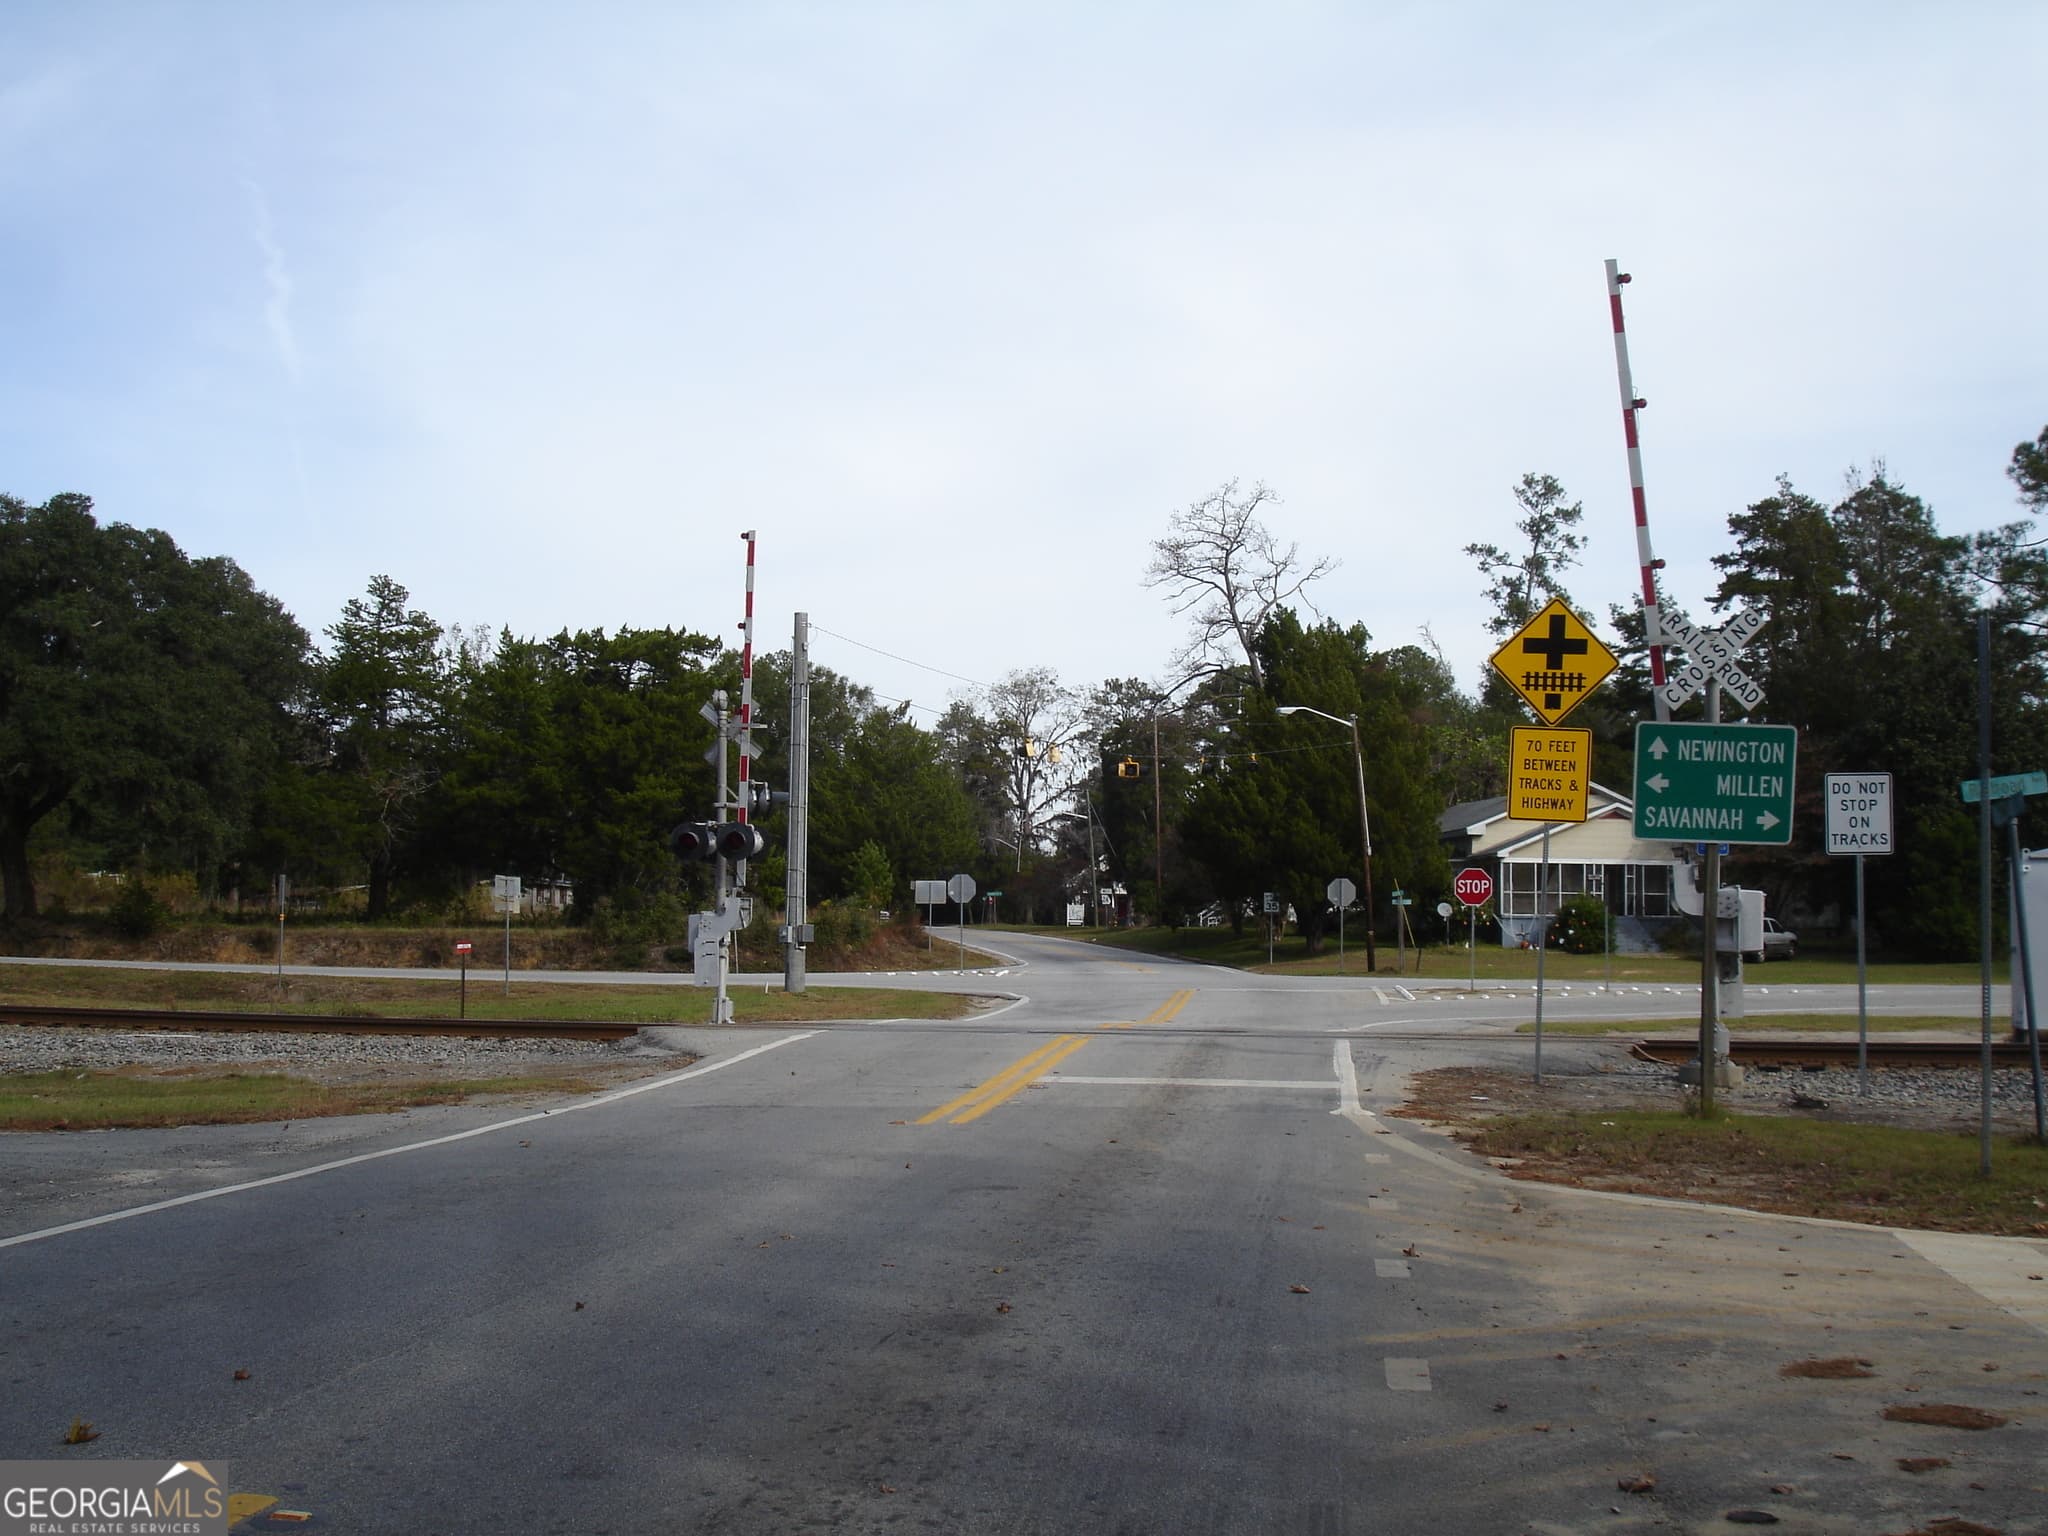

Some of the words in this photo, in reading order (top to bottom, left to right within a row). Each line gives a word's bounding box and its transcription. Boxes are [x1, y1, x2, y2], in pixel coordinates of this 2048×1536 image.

[1666, 613, 1759, 703] CROSSING
[1666, 613, 1705, 656] RAIL
[1716, 662, 1759, 704] ROAD
[1527, 740, 1542, 752] 70
[1549, 740, 1577, 753] FEET
[1678, 739, 1785, 764] NEWINGTON
[1523, 758, 1577, 772] BETWEEN
[1519, 777, 1562, 791] TRACKS
[1569, 779, 1579, 792] &
[1716, 774, 1784, 798] MILLEN
[1832, 782, 1851, 795] DO
[1859, 782, 1886, 794] NOT
[1521, 797, 1574, 811] HIGHWAY
[1840, 799, 1878, 812] STOP
[1644, 806, 1744, 831] SAVANNAH
[1849, 816, 1870, 829] ON
[1831, 833, 1889, 846] TRACKS
[1457, 879, 1490, 894] STOP
